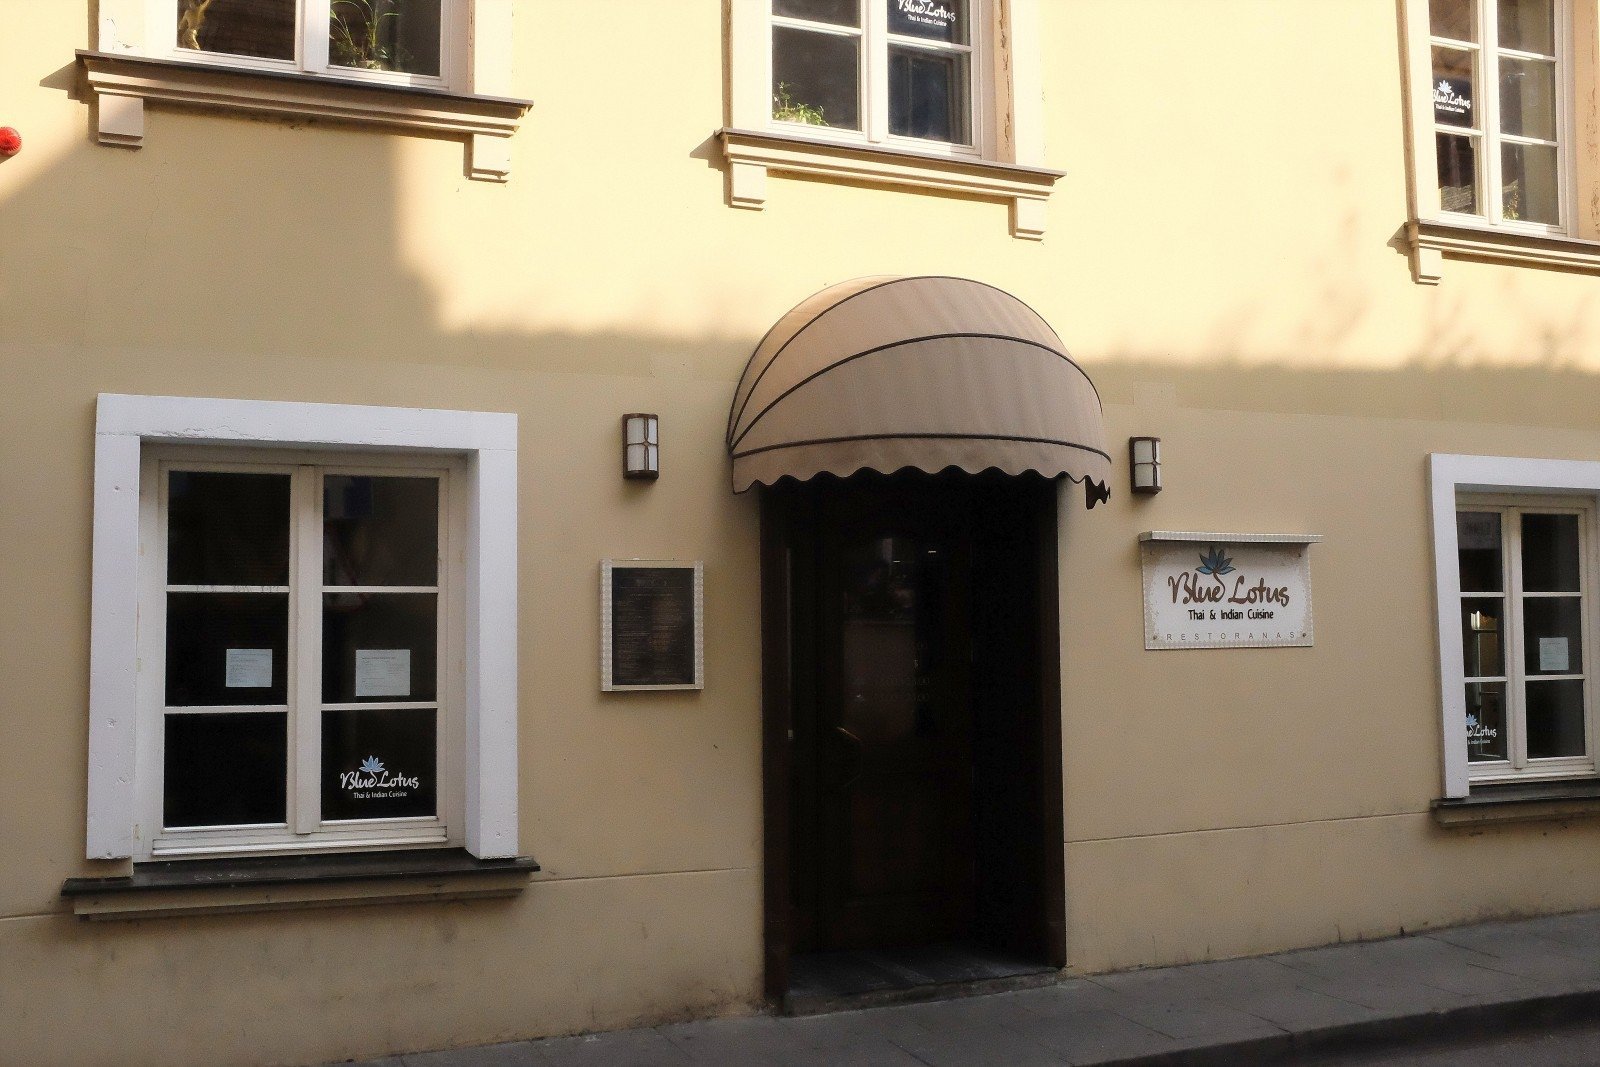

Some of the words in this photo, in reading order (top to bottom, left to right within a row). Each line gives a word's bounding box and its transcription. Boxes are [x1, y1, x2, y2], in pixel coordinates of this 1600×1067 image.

[925, 2, 956, 22] Lotus
[1448, 92, 1471, 109] Lotus
[1168, 571, 1225, 604] Blue
[1228, 575, 1290, 607] Lotus
[1188, 609, 1205, 621] Thai
[1210, 609, 1217, 620] &
[1221, 609, 1244, 620] Indian
[1247, 608, 1274, 620] Cuisine
[1166, 631, 1296, 641] RESTORANAS
[1473, 724, 1497, 737] Lotus
[340, 771, 378, 790] Blue
[376, 770, 420, 789] Lotus
[371, 791, 388, 799] Indian
[388, 790, 408, 798] Cuisine
